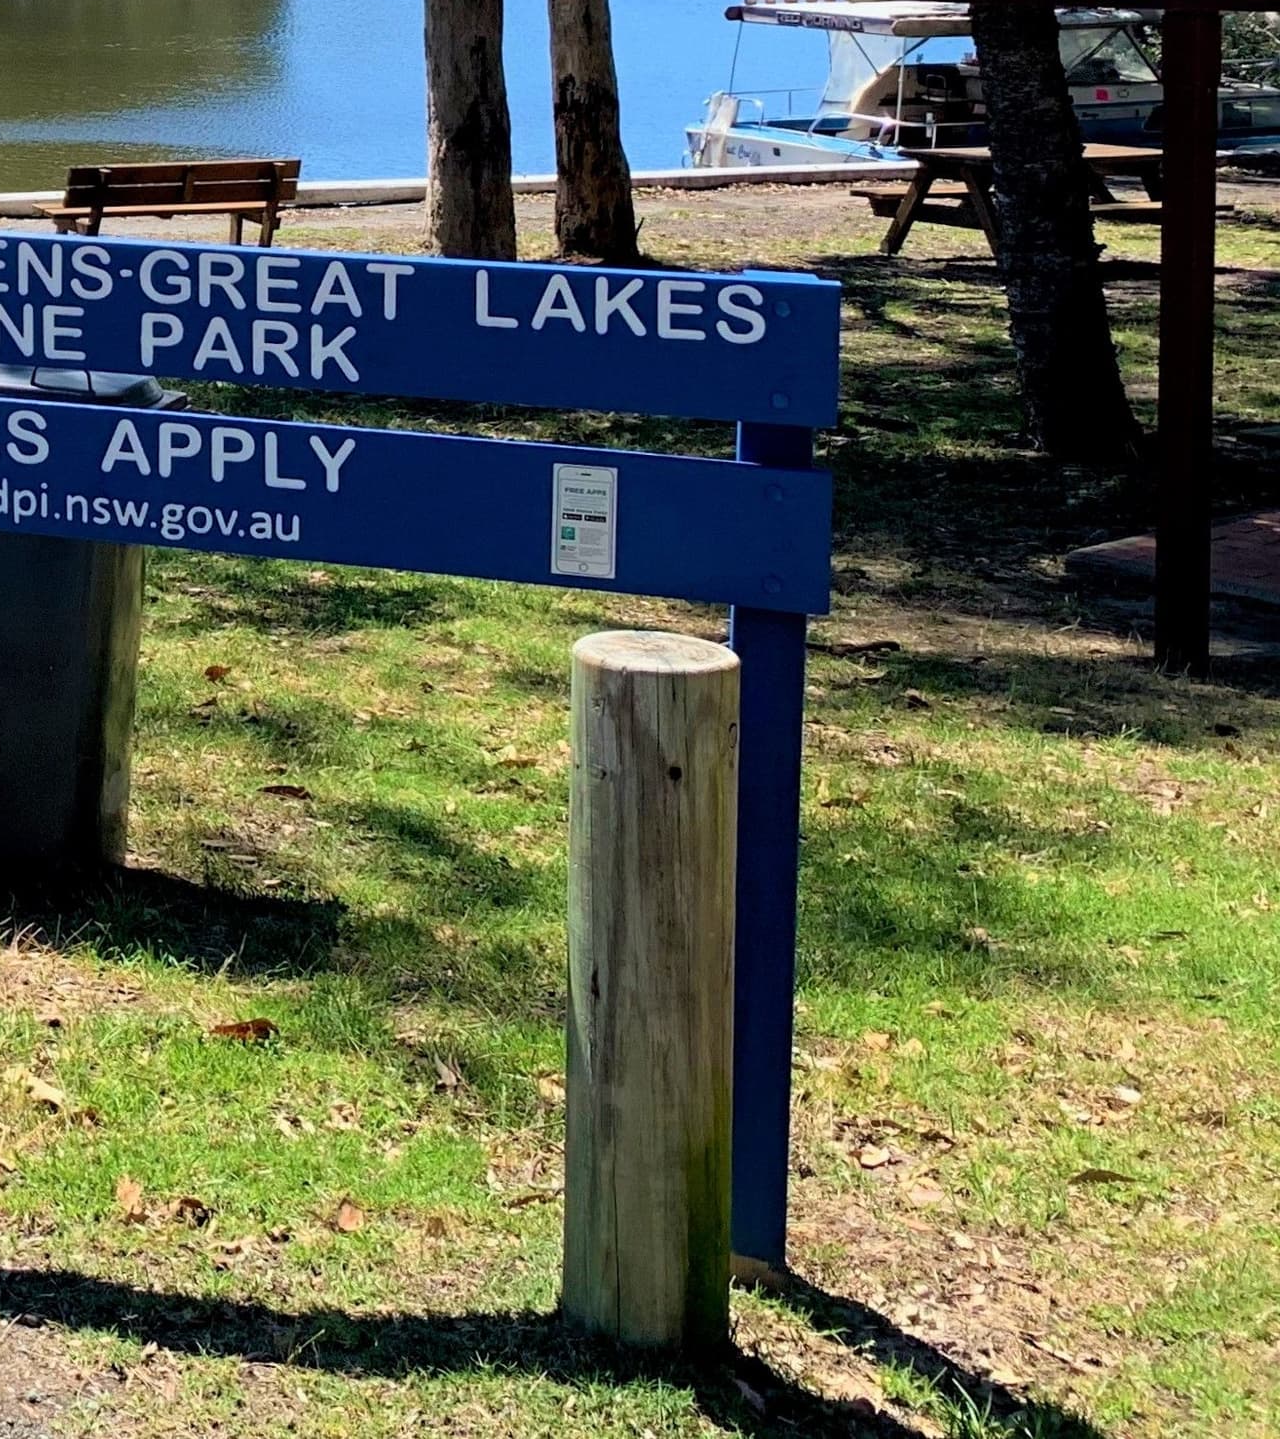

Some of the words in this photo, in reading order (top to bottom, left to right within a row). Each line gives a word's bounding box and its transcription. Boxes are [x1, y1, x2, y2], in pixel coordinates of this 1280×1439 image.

[476, 269, 766, 344] LAKES
[140, 312, 359, 382] PARK
[101, 419, 356, 492] APPLY
